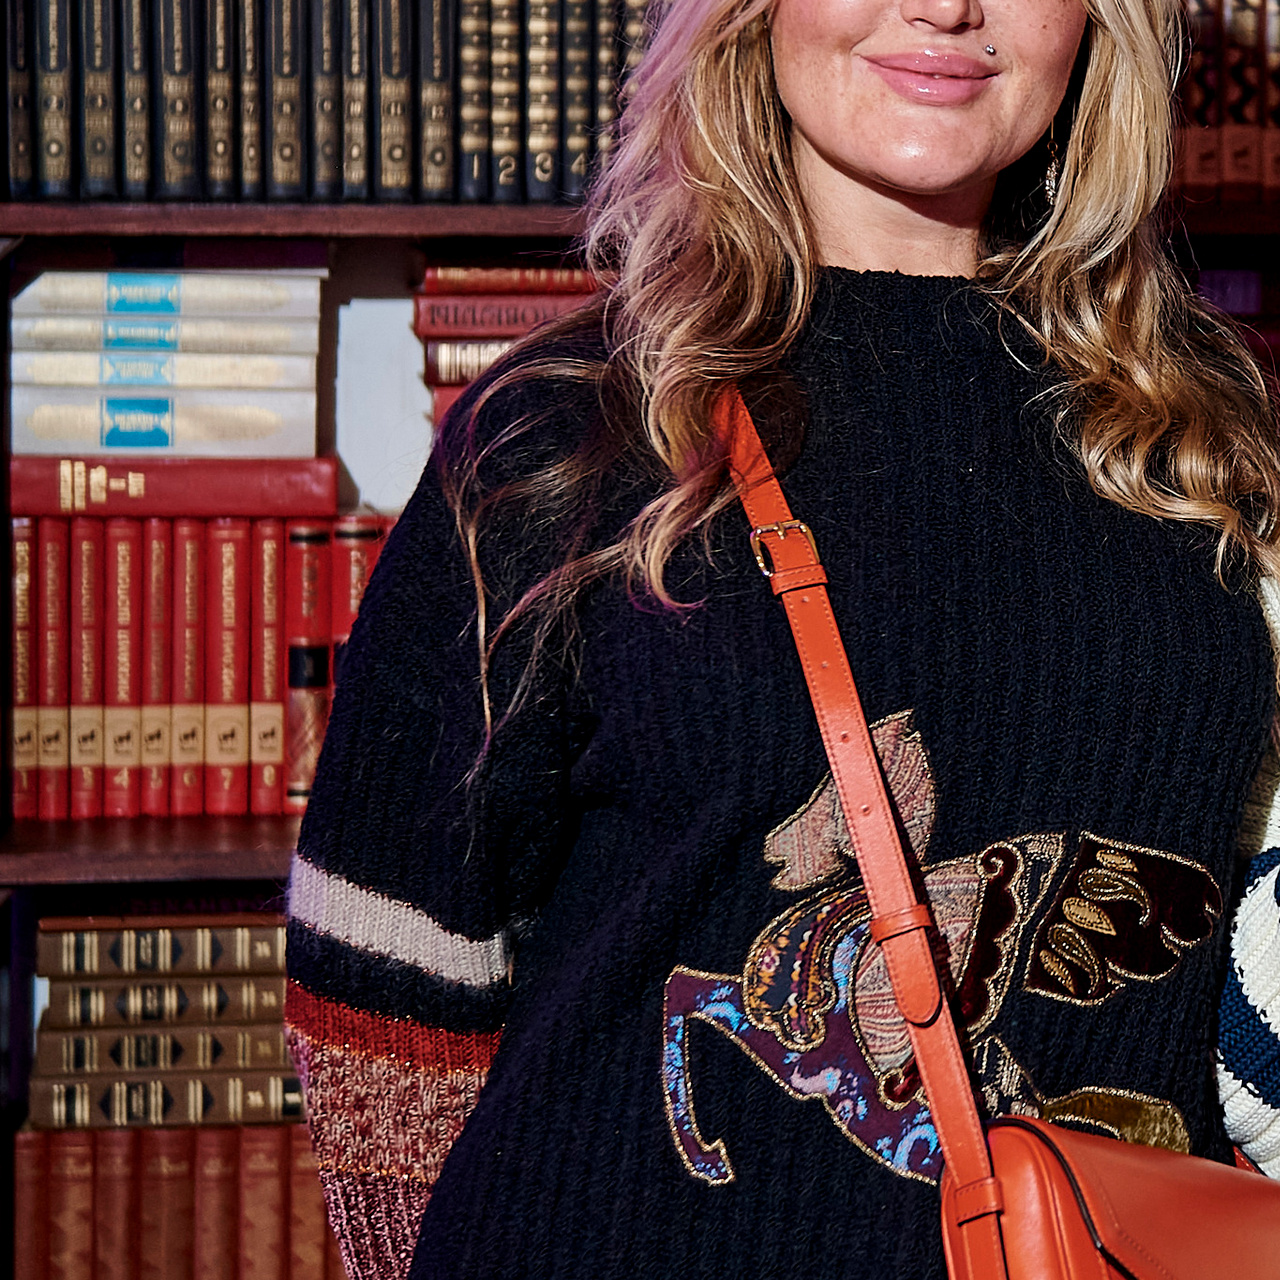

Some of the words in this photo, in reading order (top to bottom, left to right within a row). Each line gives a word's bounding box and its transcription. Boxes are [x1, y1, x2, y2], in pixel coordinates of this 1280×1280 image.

[499, 155, 516, 185] 2
[571, 152, 588, 177] 4
[113, 766, 129, 789] 4
[221, 767, 233, 789] 7
